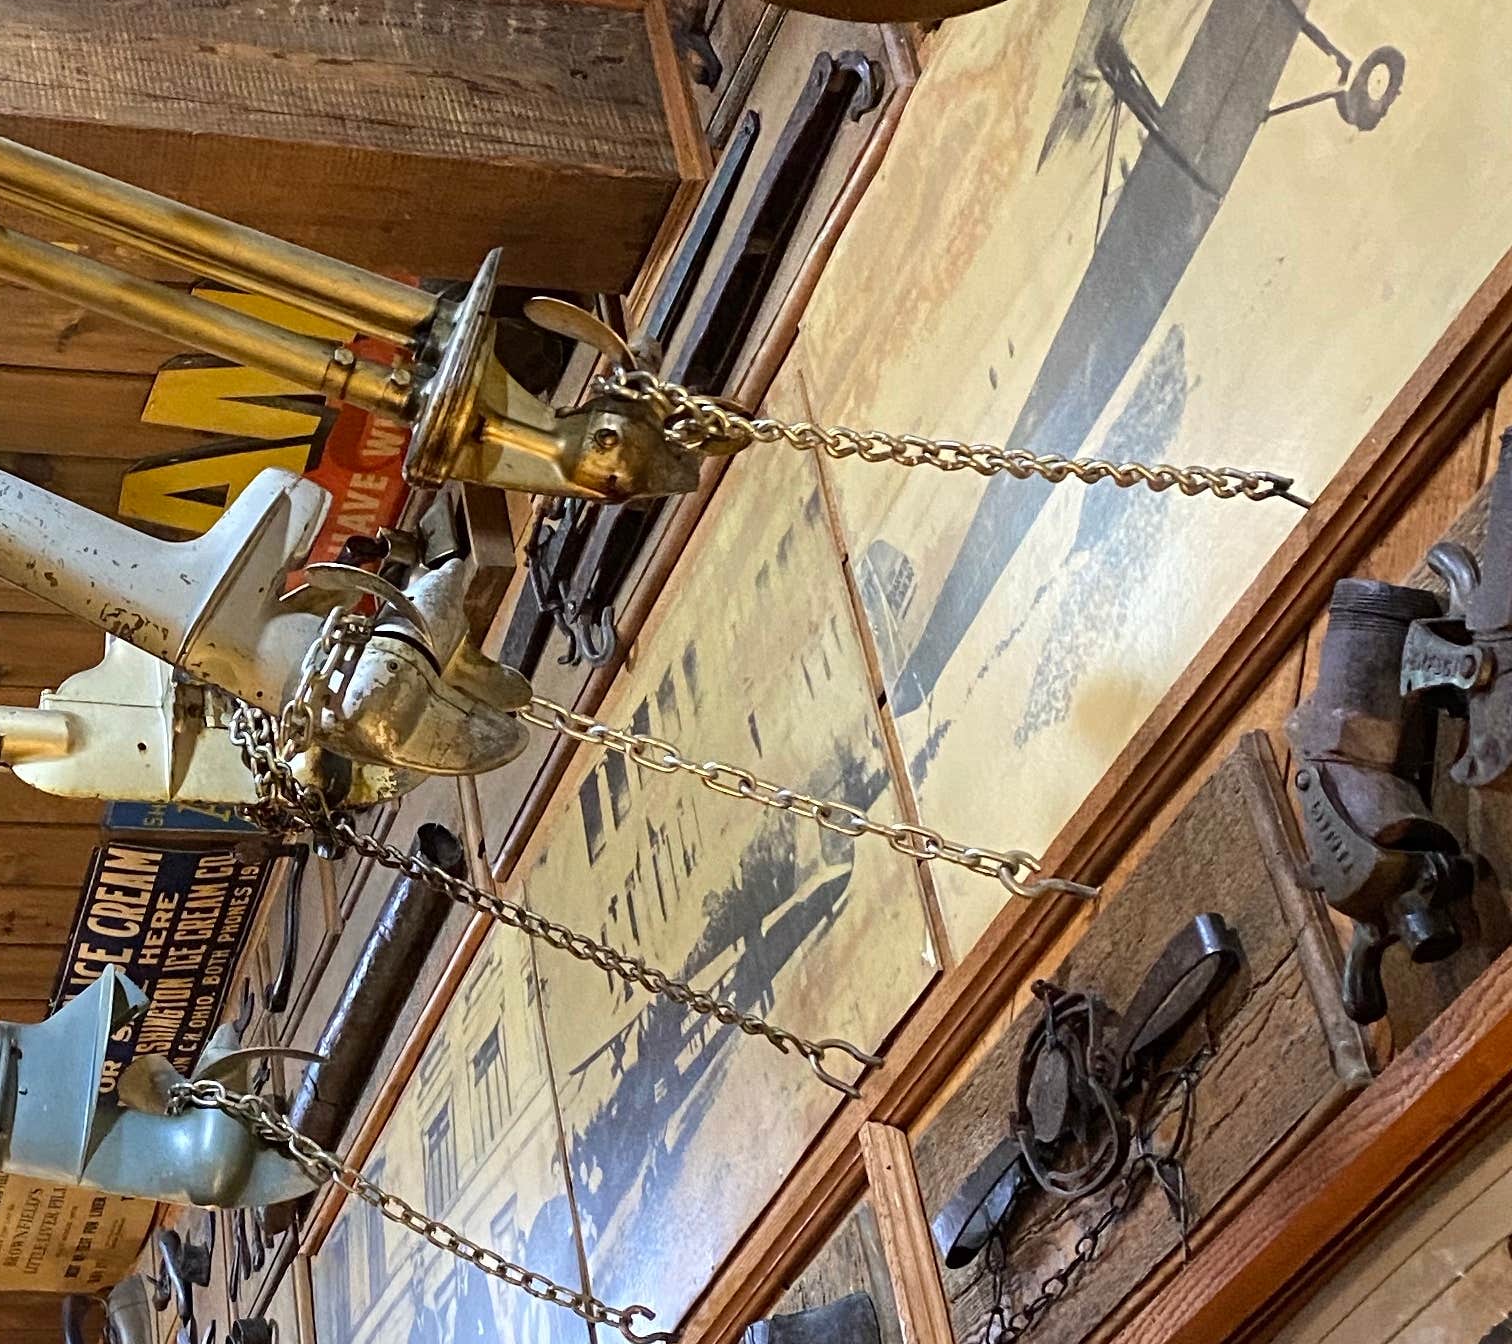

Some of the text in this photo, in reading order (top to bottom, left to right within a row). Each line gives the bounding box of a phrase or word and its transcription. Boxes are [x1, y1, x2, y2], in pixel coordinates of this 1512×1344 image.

[88, 847, 164, 938] CREAM
[174, 882, 230, 941] CREAM
[202, 950, 230, 987] BOTH
[217, 886, 254, 944] PHONES
[98, 891, 180, 1095] OR HERE
[162, 943, 207, 972] ICE
